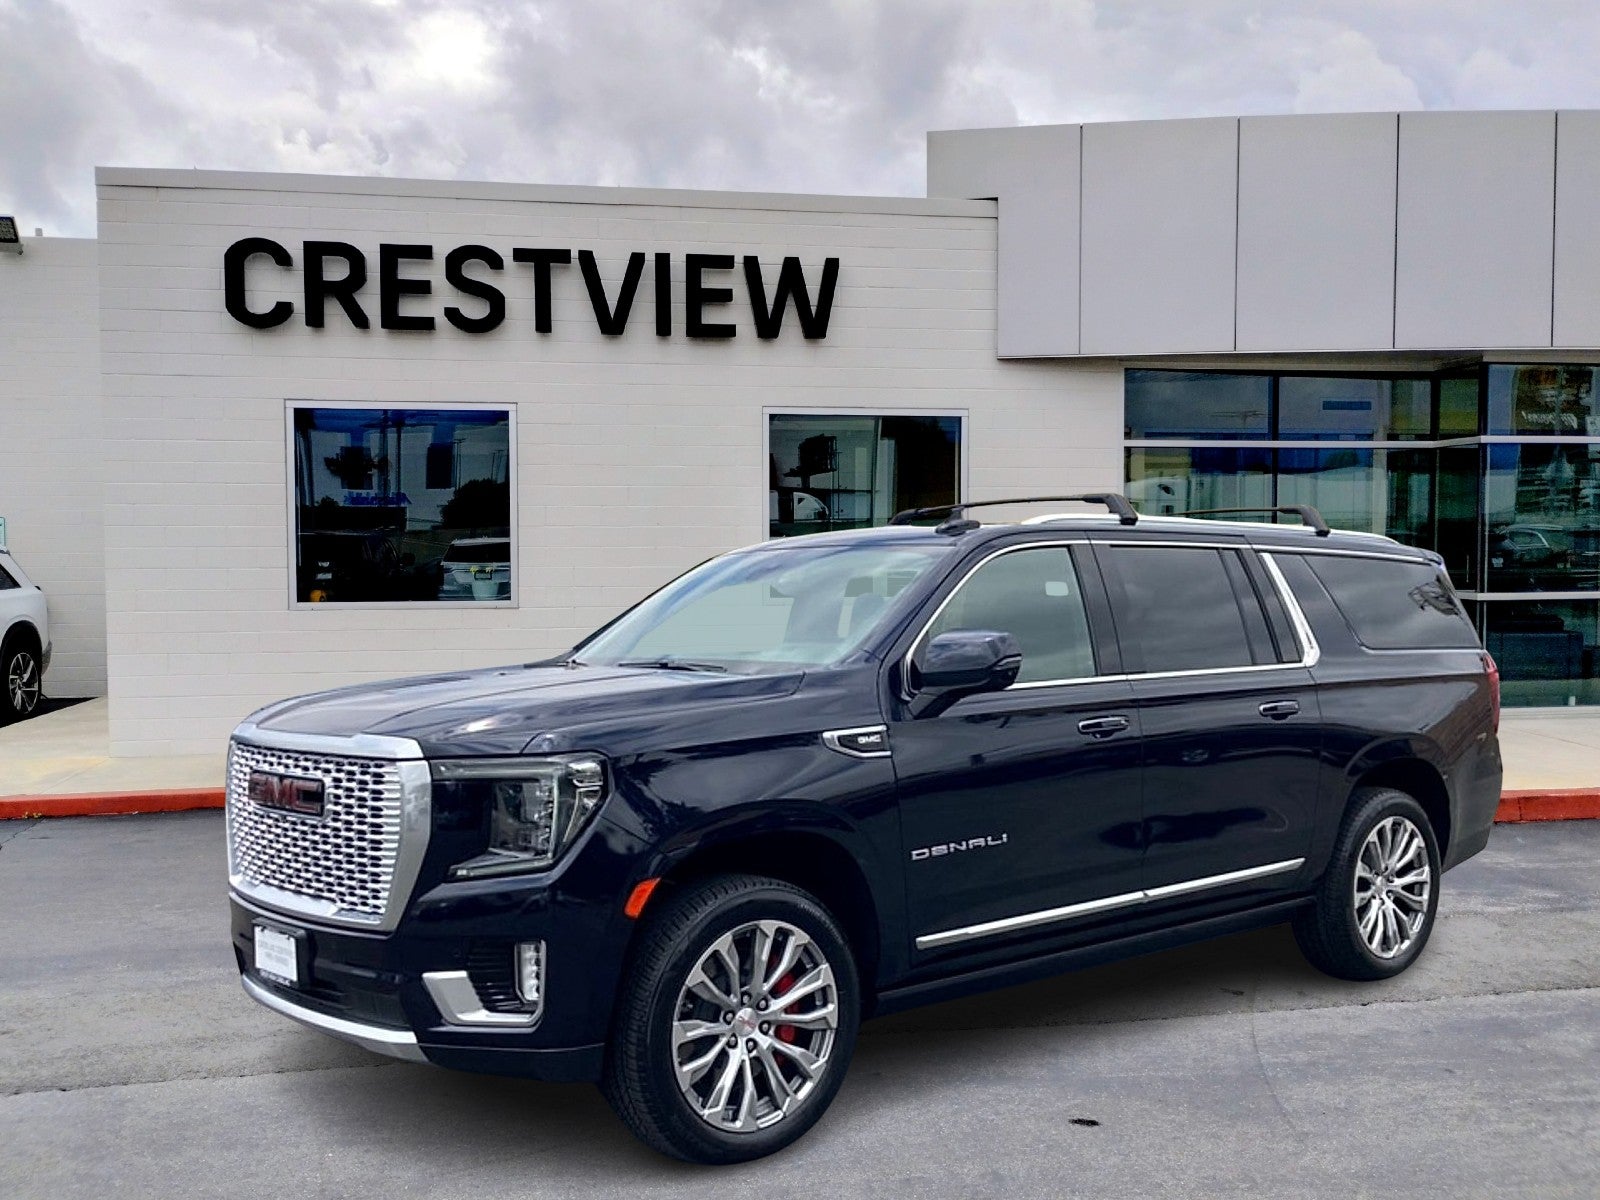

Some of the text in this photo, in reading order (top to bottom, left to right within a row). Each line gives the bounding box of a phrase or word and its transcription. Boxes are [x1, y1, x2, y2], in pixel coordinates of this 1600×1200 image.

[223, 237, 840, 340] CRESTVIEW
[857, 734, 882, 744] GMC
[248, 771, 321, 814] GMC
[911, 833, 1008, 861] DENALI
